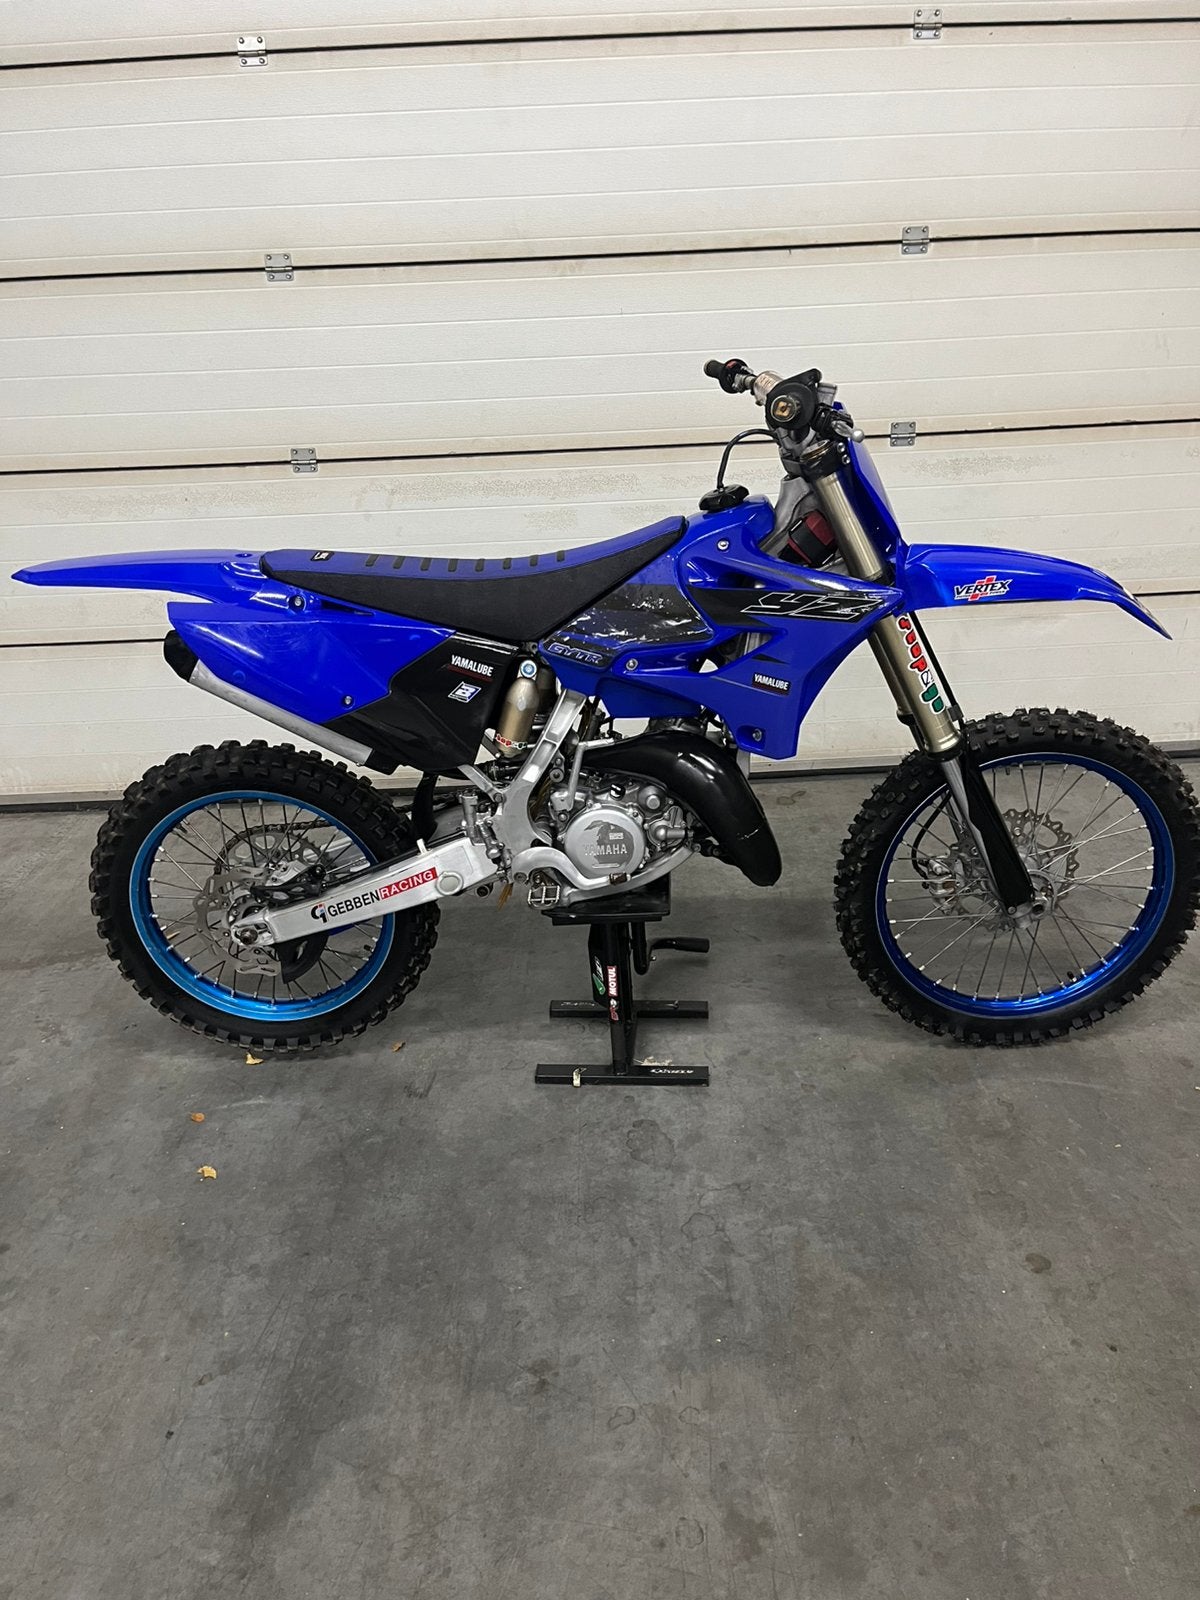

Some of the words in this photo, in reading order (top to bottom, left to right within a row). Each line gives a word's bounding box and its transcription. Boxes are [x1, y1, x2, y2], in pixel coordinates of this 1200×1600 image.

[954, 580, 1012, 597] VERTEX
[740, 592, 882, 620] YZ
[451, 654, 494, 677] YAMALUBE
[754, 673, 789, 691] YAMALUBE
[583, 843, 628, 857] YAMAHA
[608, 966, 618, 996] MOTUL
